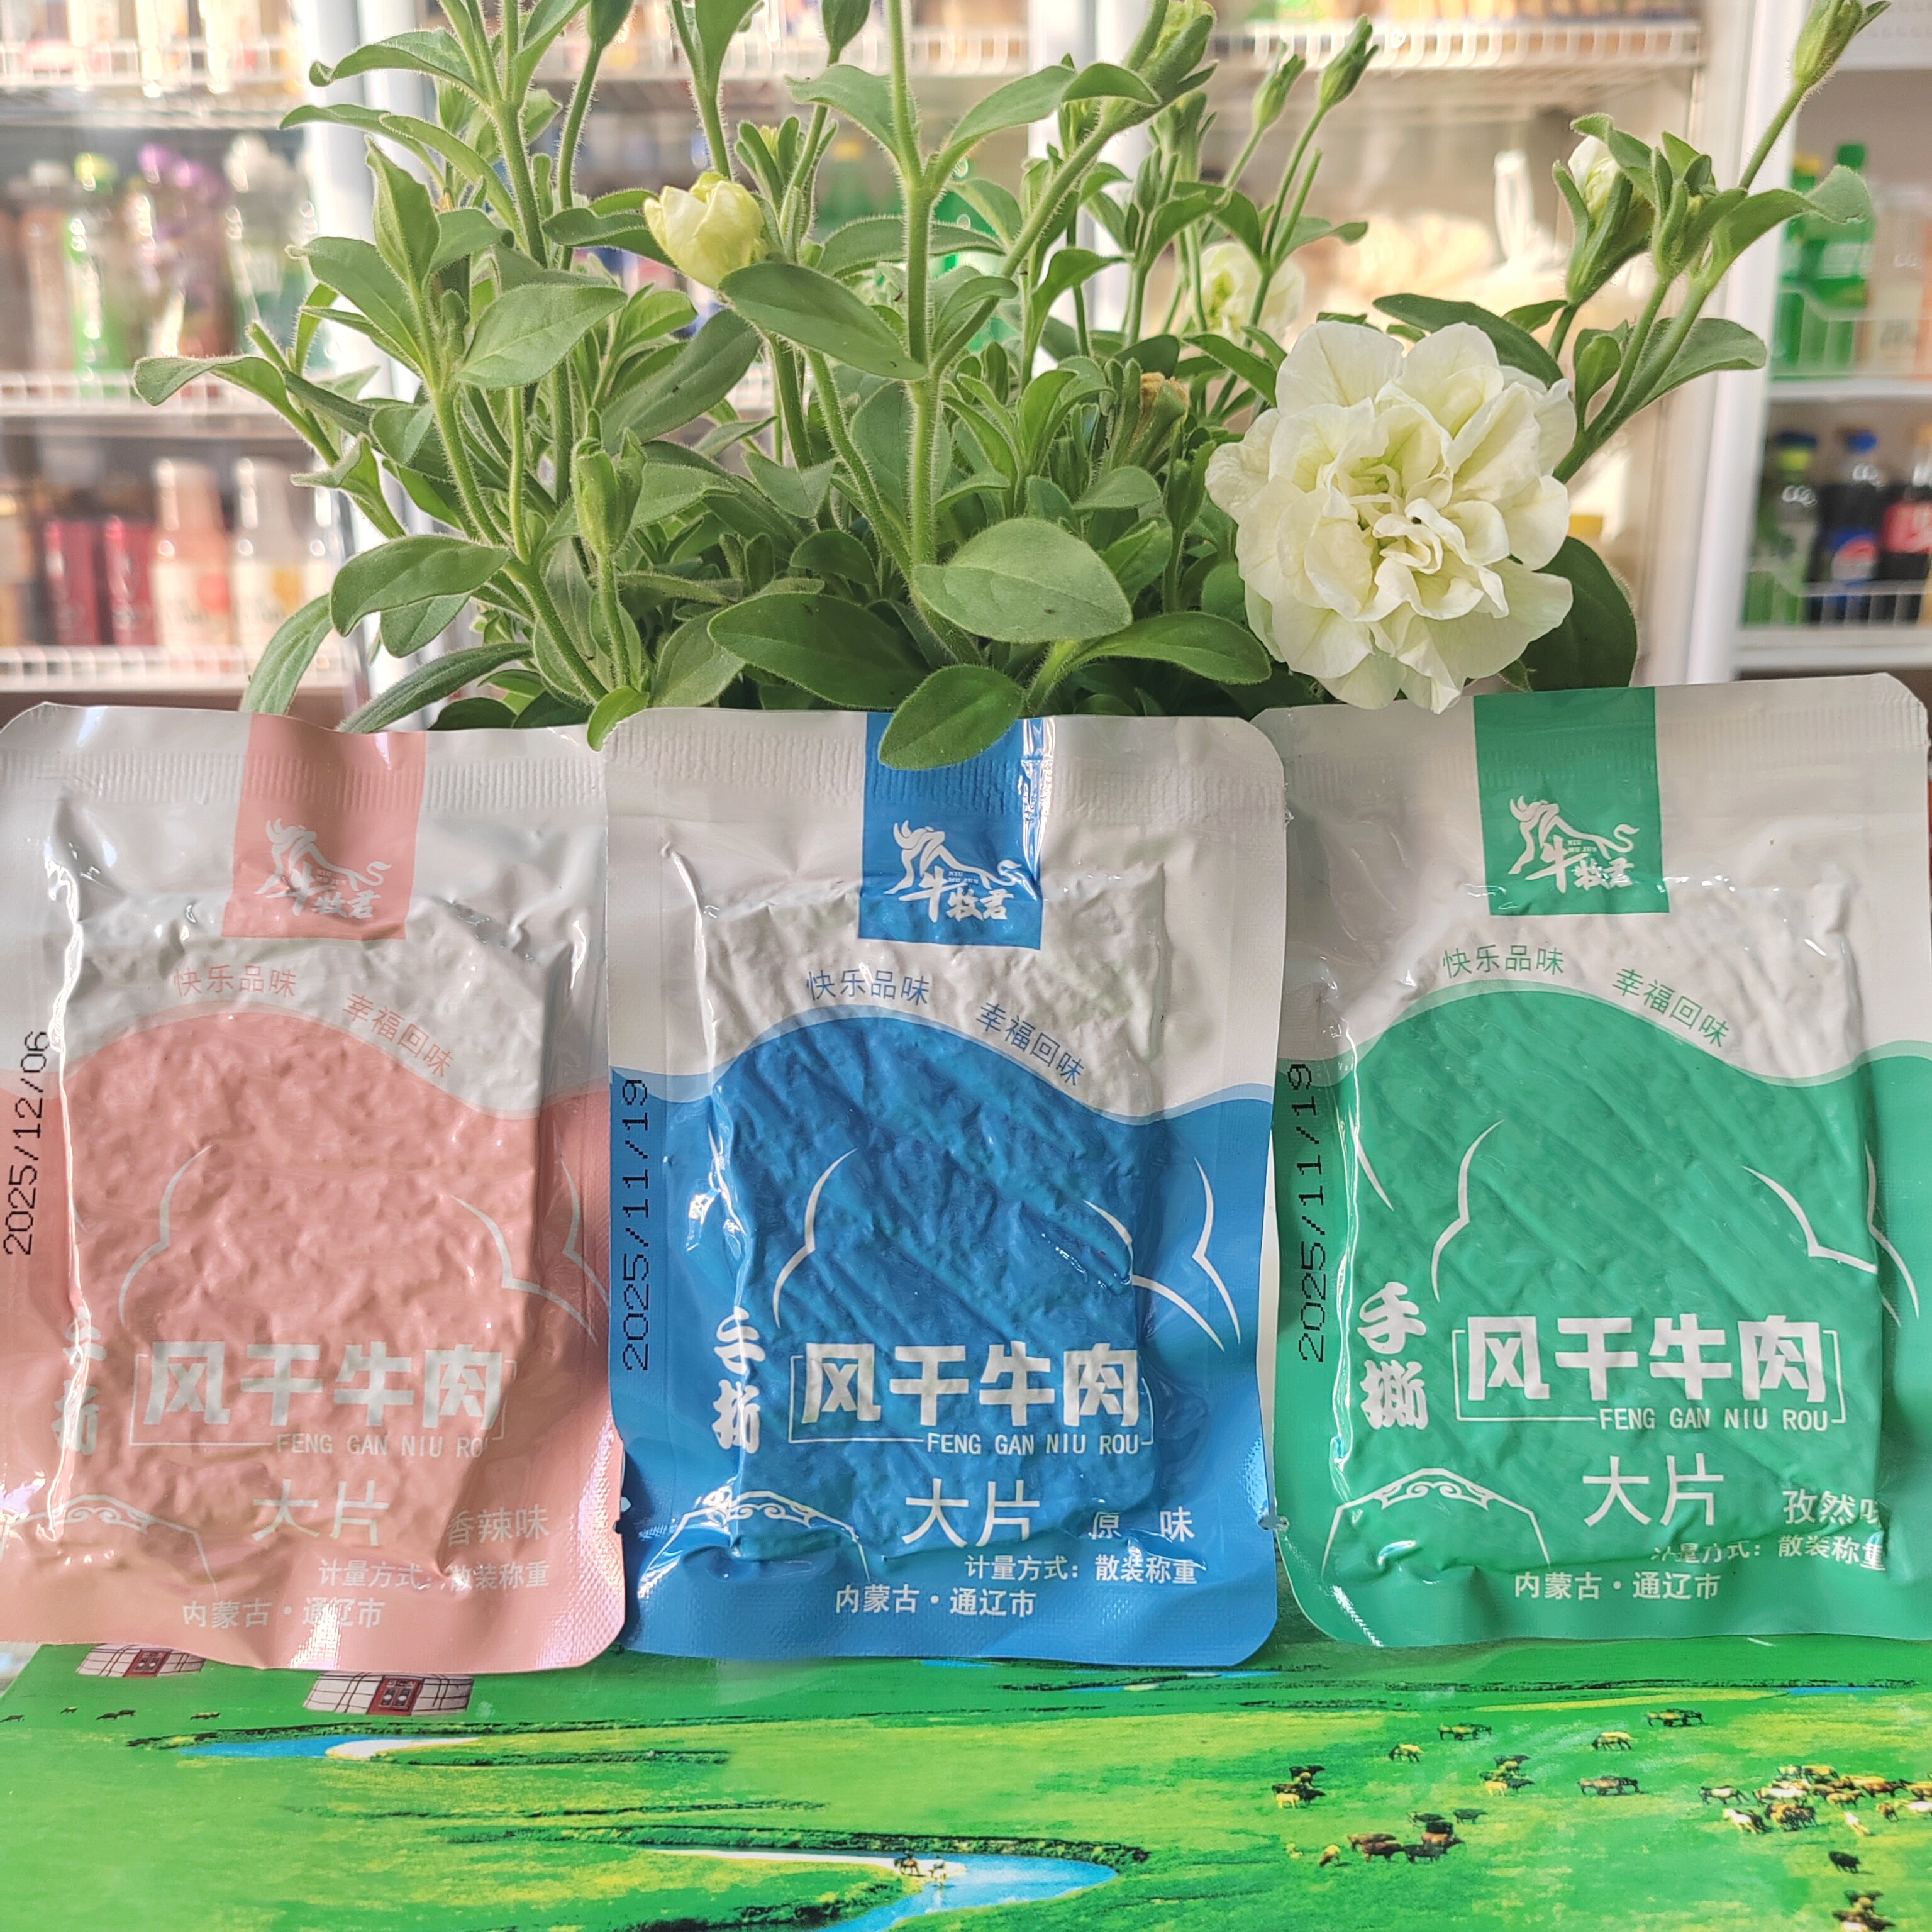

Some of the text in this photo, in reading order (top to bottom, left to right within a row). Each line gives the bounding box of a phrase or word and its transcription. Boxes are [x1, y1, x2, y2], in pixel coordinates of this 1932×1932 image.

[898, 865, 1014, 923] 牛牧君
[174, 964, 297, 998] 快乐品味
[806, 969, 930, 1006] 快乐品味
[1442, 944, 1564, 977] 快乐品味
[342, 992, 455, 1076] 幸福回味
[975, 1001, 1085, 1086] 幸福回味
[1612, 968, 1731, 1048] 幸福回味
[3, 1031, 50, 1255] 2025/12/06
[622, 1079, 649, 1371] 2025/11/19
[1287, 1063, 1326, 1363] 2025/11/19
[143, 1341, 504, 1428] 风干牛肉
[802, 1341, 1140, 1426] 风干牛肉
[1358, 1281, 1427, 1430] 手撕
[1467, 1313, 1825, 1403] 风干牛肉
[277, 1433, 333, 1455] FENG
[347, 1434, 388, 1456] GAN
[402, 1435, 443, 1458] NIU
[928, 1433, 1138, 1455] FENG GAN NIU ROU
[1601, 1409, 1828, 1432] FENG GAN NIU ROU
[253, 1478, 390, 1546] 大片
[448, 1504, 550, 1547] 香辣味
[902, 1479, 1039, 1546] 大片
[1582, 1454, 1724, 1527] 大片
